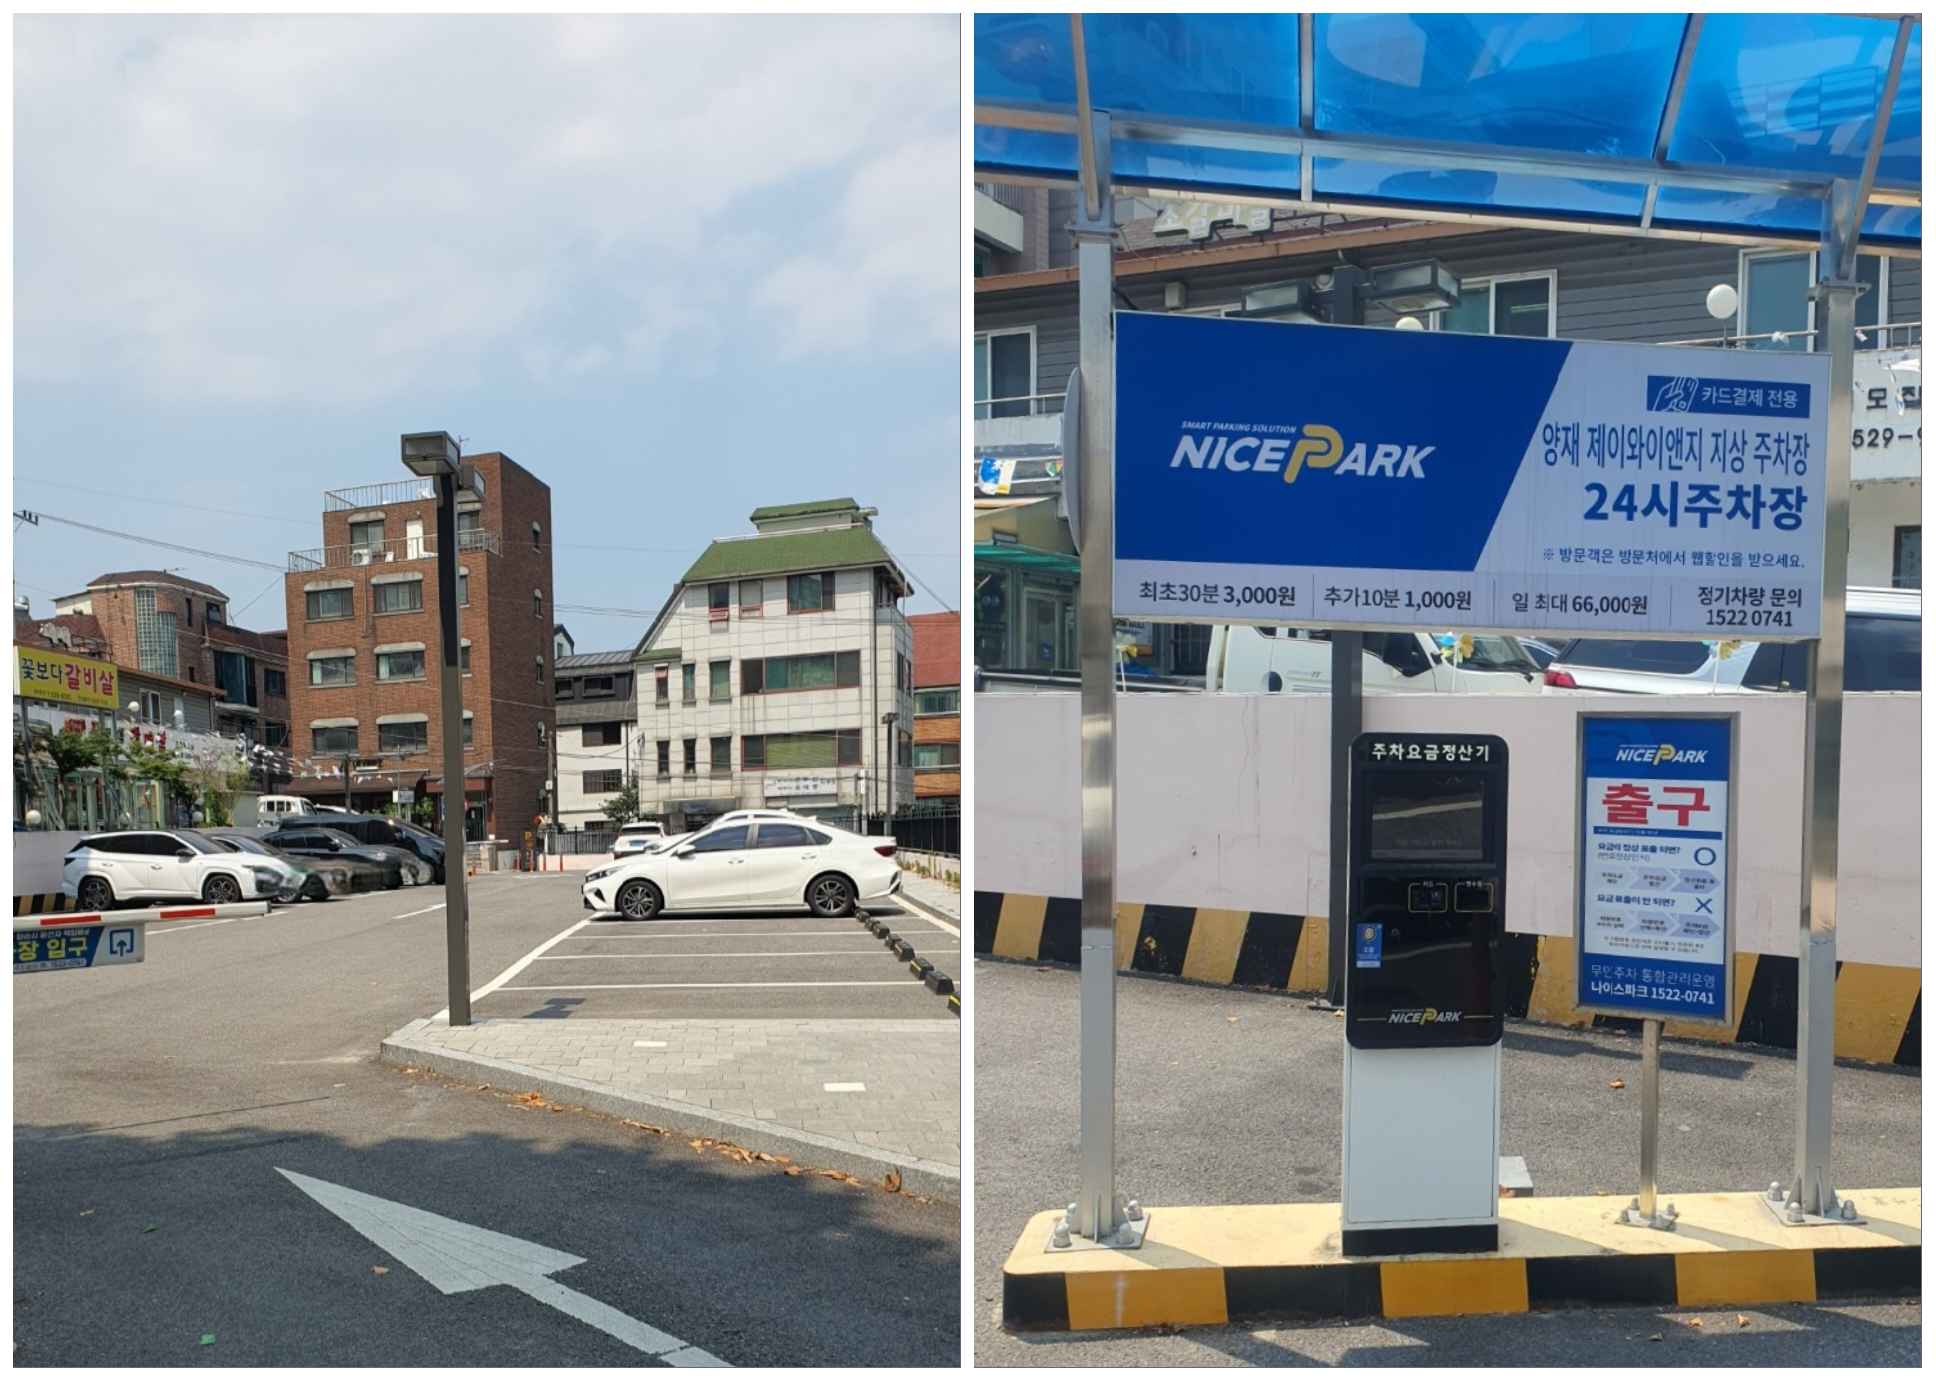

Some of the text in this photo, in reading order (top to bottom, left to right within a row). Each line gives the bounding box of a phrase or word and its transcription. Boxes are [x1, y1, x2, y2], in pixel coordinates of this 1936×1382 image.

[1701, 387, 1799, 410] 카드결제 전용
[1181, 420, 1297, 434] SMART PARKING SOLUTION
[1851, 427, 1921, 449] 529-
[1169, 423, 1437, 484] NICEPARK
[1542, 421, 1810, 477] 양재 제이와이앤지 지상 주차장
[1583, 481, 1808, 531] 24시주차장
[1559, 547, 1614, 565] 방문객은
[1619, 549, 1686, 566] 방문처에서
[1749, 552, 1805, 569] 받으세요.
[1139, 580, 1296, 607] 최초30분 3,000원
[1324, 586, 1472, 613] 추가10분 1,000원
[1512, 593, 1648, 616] 일 최대 66,000원
[1698, 587, 1803, 609] 정기차량 문의
[1707, 609, 1793, 628] 1522 0741
[22, 658, 115, 697] 꽃보다 갈비살
[1372, 743, 1490, 762] 주차요금정산기
[1615, 744, 1709, 766] NICEPARK
[1602, 783, 1711, 827] 출구
[13, 937, 88, 962] 장 입구
[1591, 964, 1716, 989] 무인주차 통합관리운영
[1591, 981, 1715, 1005] 나이스파크 1522-0741
[1388, 1007, 1462, 1026] NICEPARK
